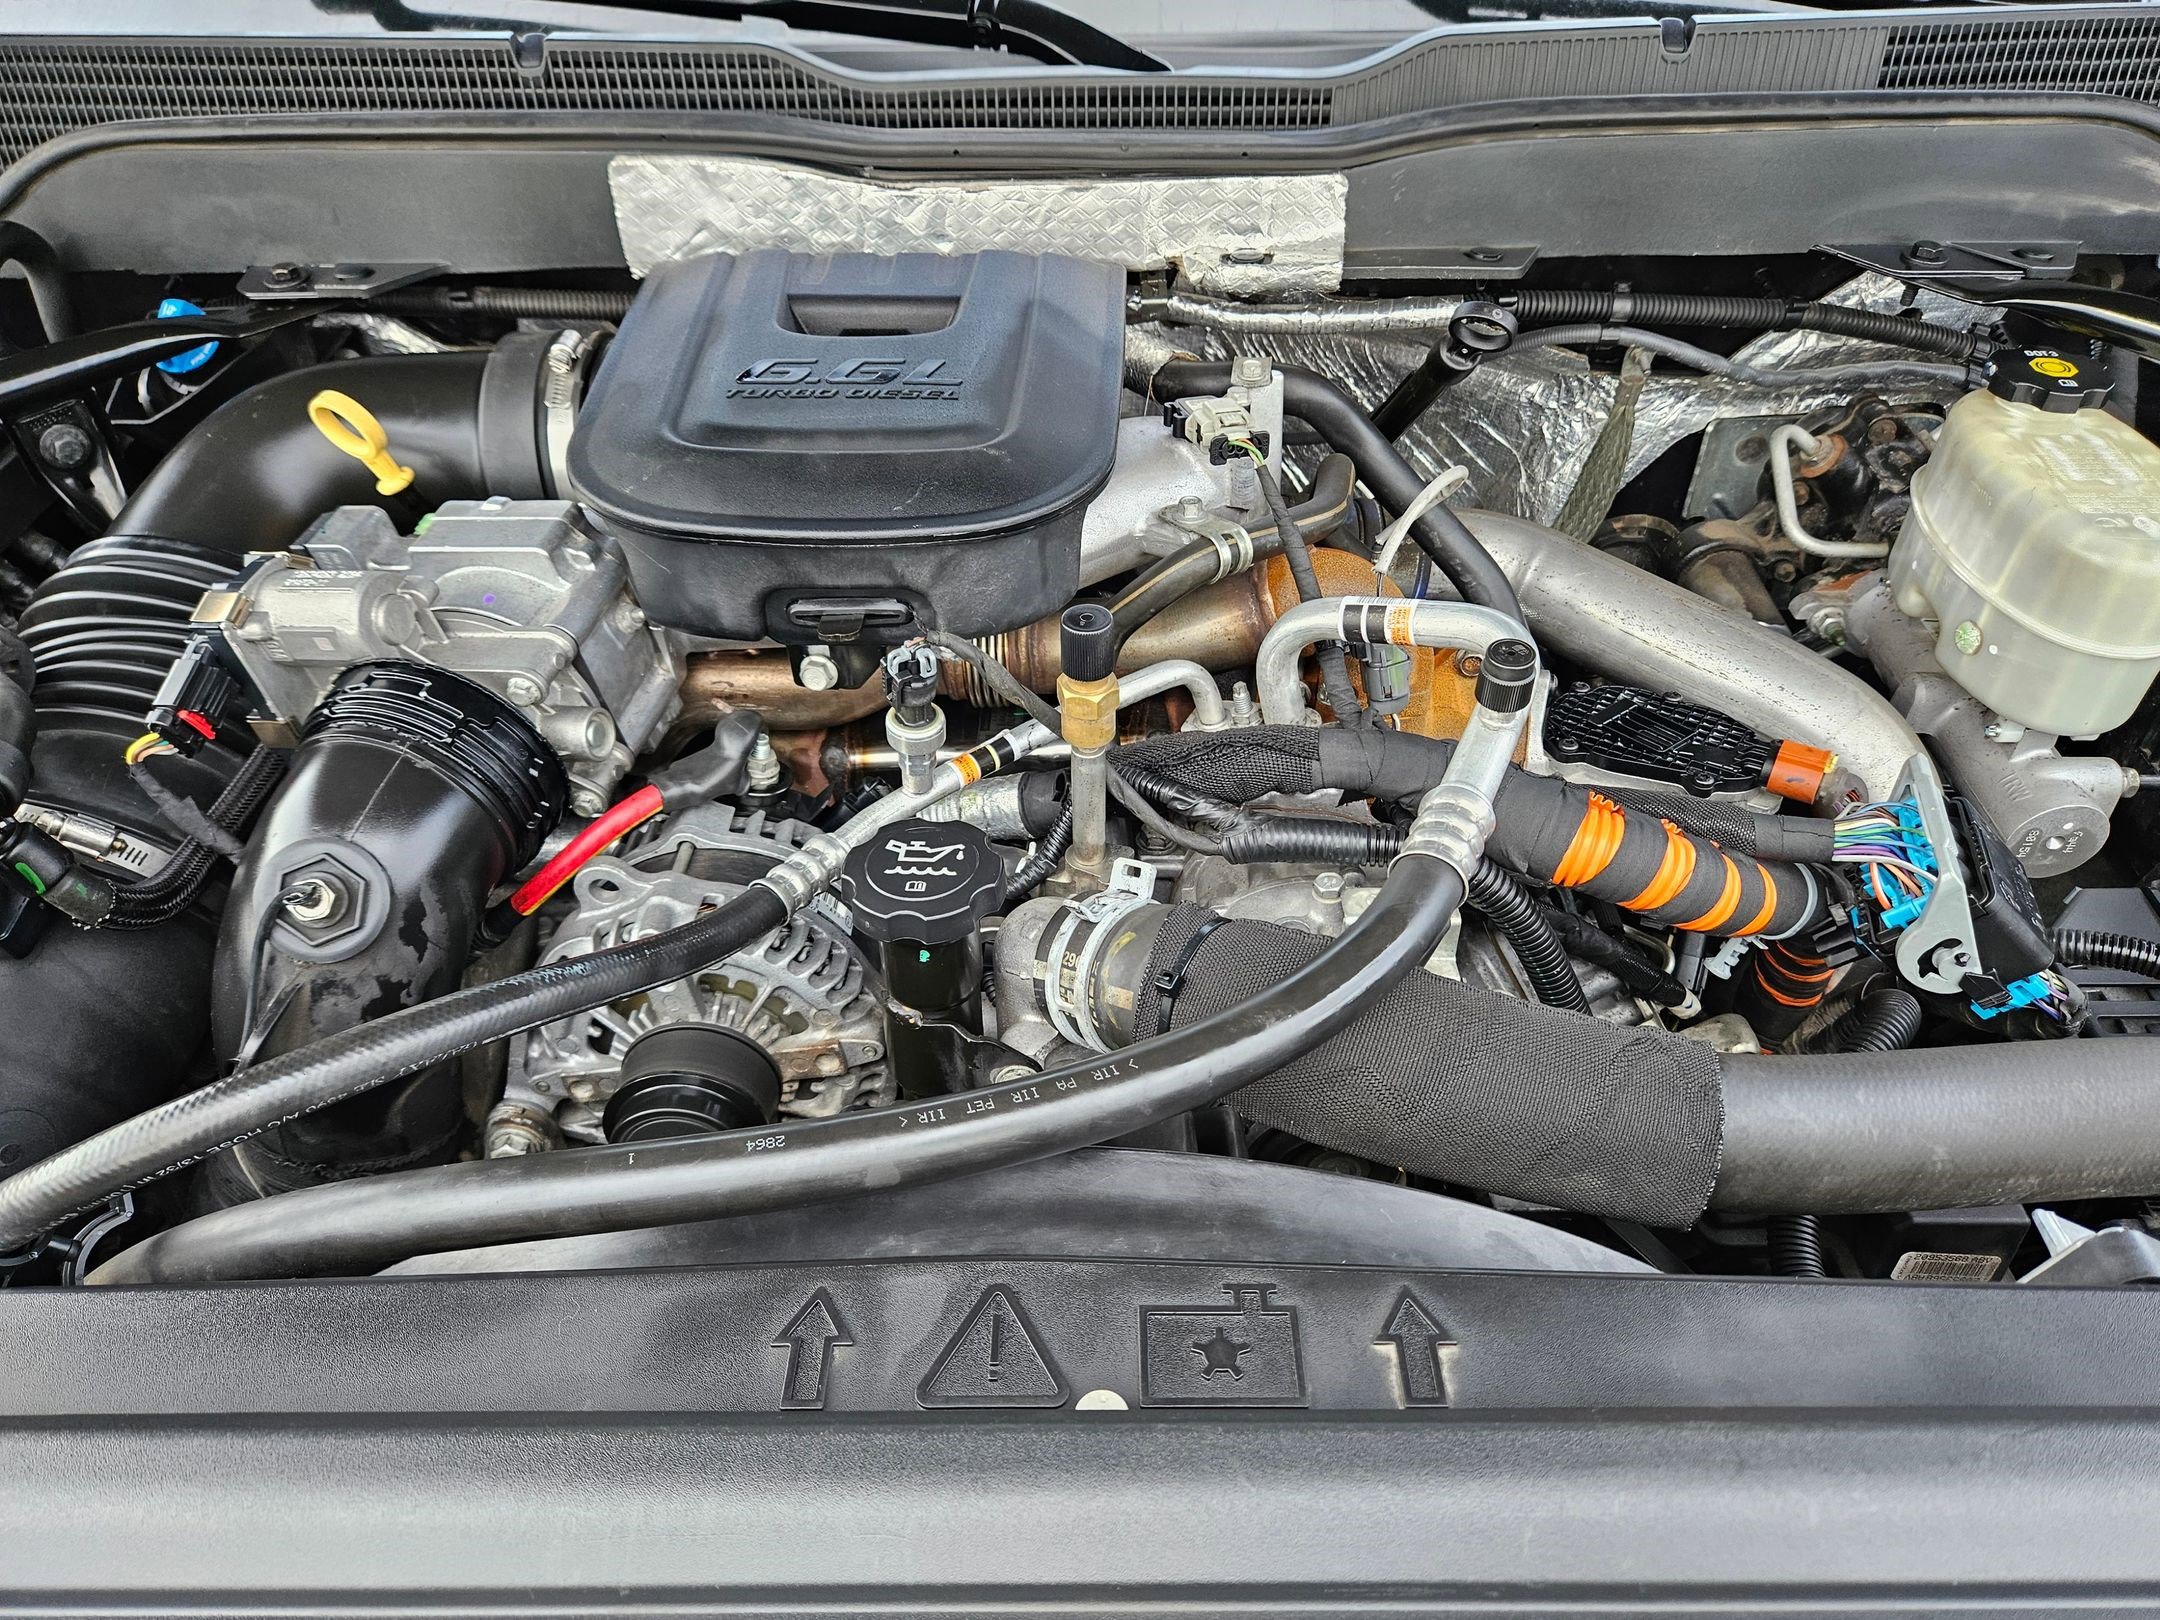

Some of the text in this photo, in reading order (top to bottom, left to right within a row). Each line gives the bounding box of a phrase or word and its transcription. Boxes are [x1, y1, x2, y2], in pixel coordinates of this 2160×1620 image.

[735, 358, 963, 386] 6.6L
[726, 388, 960, 400] TURBO DIESEL
[1091, 1064, 1121, 1082] IIR
[1055, 1077, 1078, 1091] PA
[1010, 1086, 1041, 1103] IIR
[966, 1097, 996, 1114] PET
[267, 1111, 300, 1129] A/C
[917, 1108, 947, 1124] IIR
[206, 1127, 263, 1154] HOSE
[745, 1135, 787, 1152] 2864
